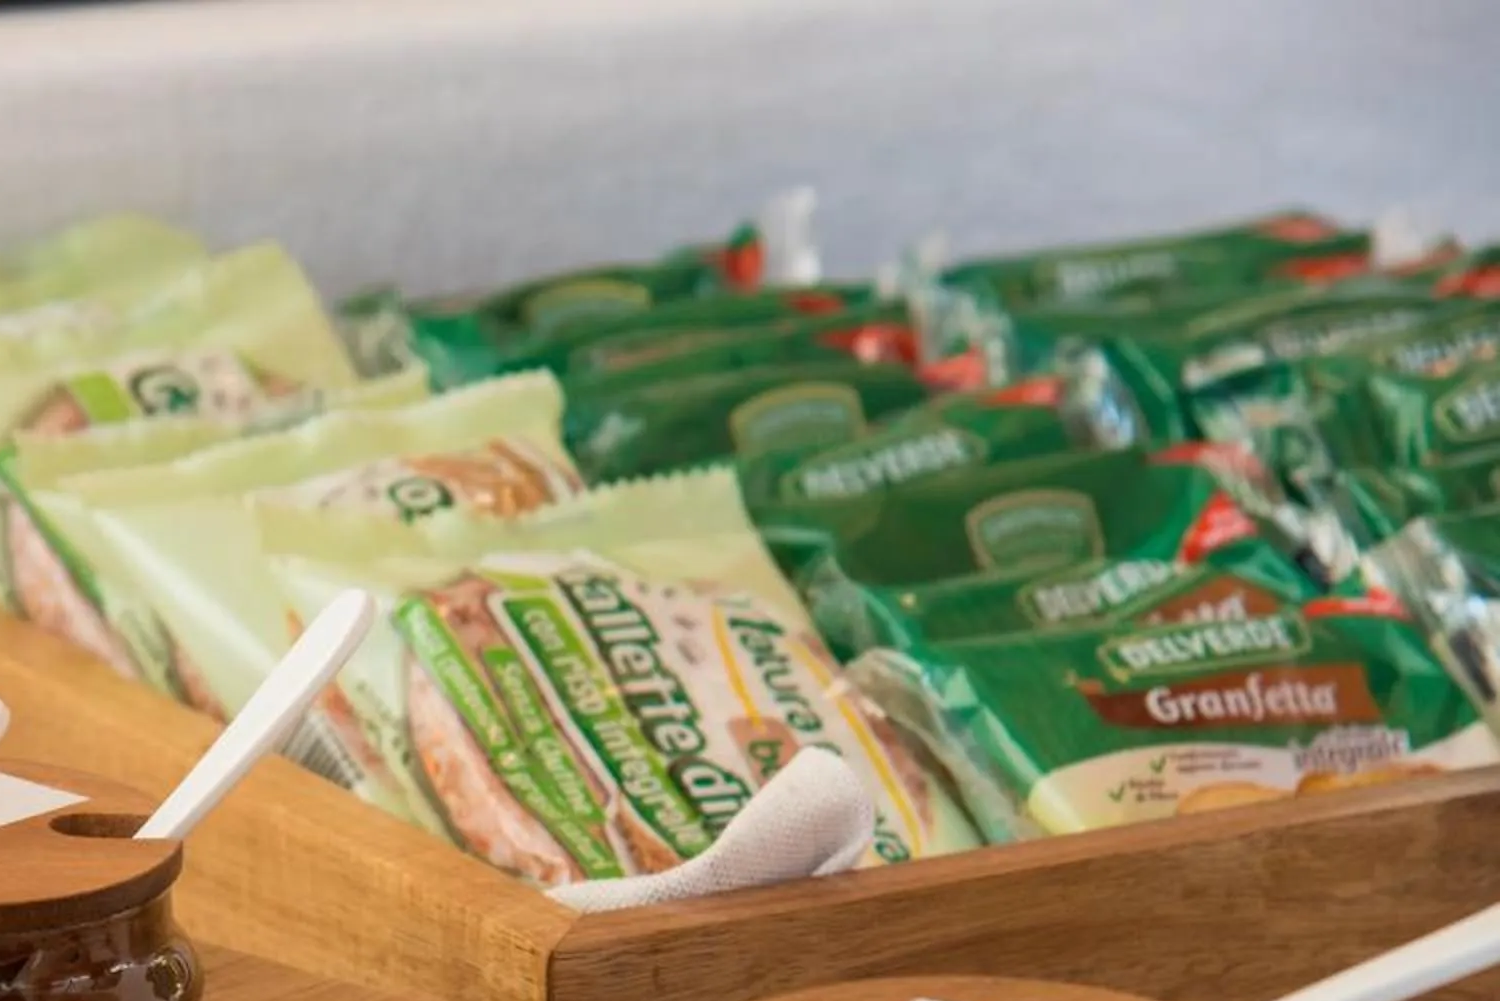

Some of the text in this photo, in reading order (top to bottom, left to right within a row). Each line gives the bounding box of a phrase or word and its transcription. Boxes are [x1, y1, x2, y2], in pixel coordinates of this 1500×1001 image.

[560, 568, 703, 755] allette
[1119, 614, 1293, 672] DELVERDE
[552, 653, 609, 715] riso
[1146, 671, 1338, 725] Granfetta
